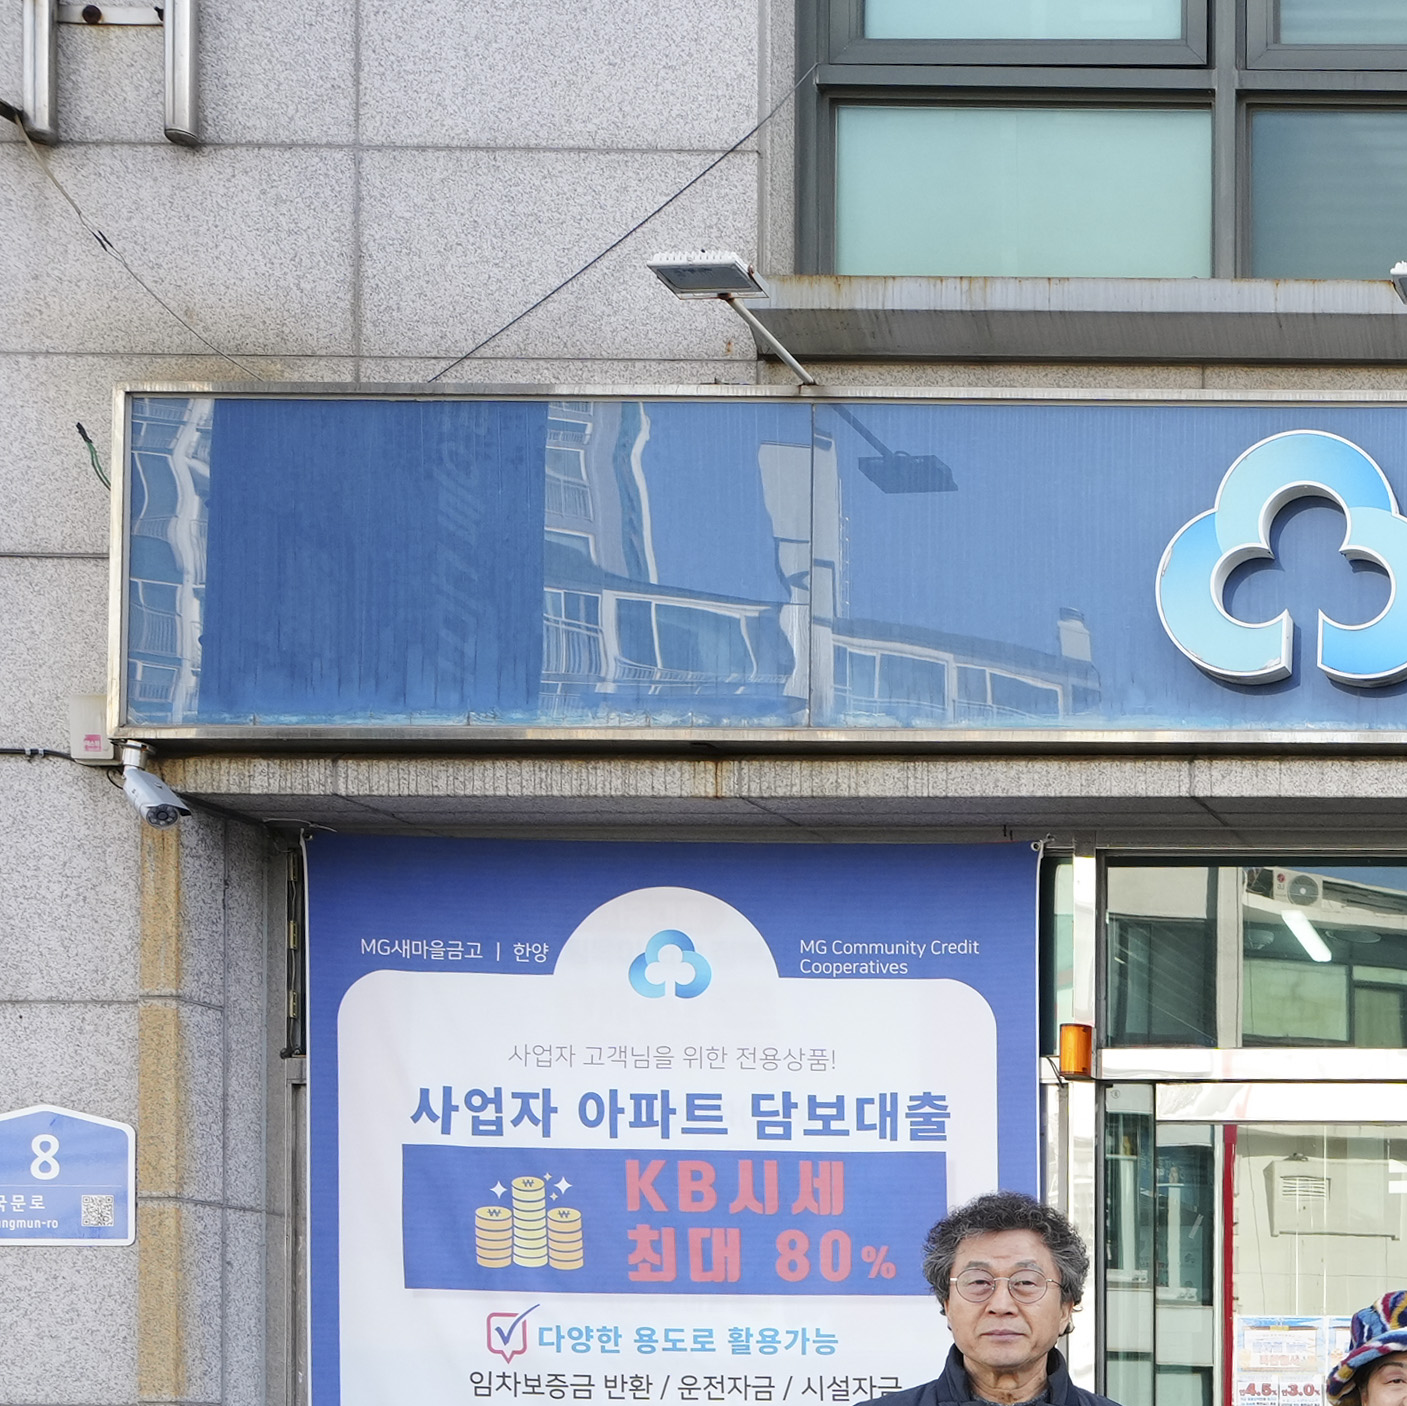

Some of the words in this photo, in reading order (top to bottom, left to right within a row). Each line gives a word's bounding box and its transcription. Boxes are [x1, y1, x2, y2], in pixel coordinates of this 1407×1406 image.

[361, 938, 483, 960] MG새마을금고
[512, 942, 549, 963] 한양
[801, 939, 826, 955] MG
[832, 938, 926, 958] Community
[931, 938, 979, 955] Credit
[800, 958, 908, 977] Cooperatives
[508, 1045, 575, 1070] 사업자
[584, 1045, 675, 1070] 고객님을
[682, 1045, 728, 1070] 위한
[735, 1046, 837, 1073] 전용상품!
[410, 1085, 558, 1138] 사업자
[577, 1089, 728, 1139] 아파트
[750, 1090, 952, 1142] 담보대출
[30, 1134, 60, 1180] 8
[627, 1228, 742, 1283] 최대
[775, 1229, 896, 1282] 80%
[538, 1324, 622, 1354] 다양한
[633, 1324, 715, 1355] 용도로
[727, 1325, 839, 1357] 활용가능
[469, 1370, 595, 1400] 임차보증금
[603, 1372, 654, 1402] 반환
[677, 1374, 776, 1401] 운전자금
